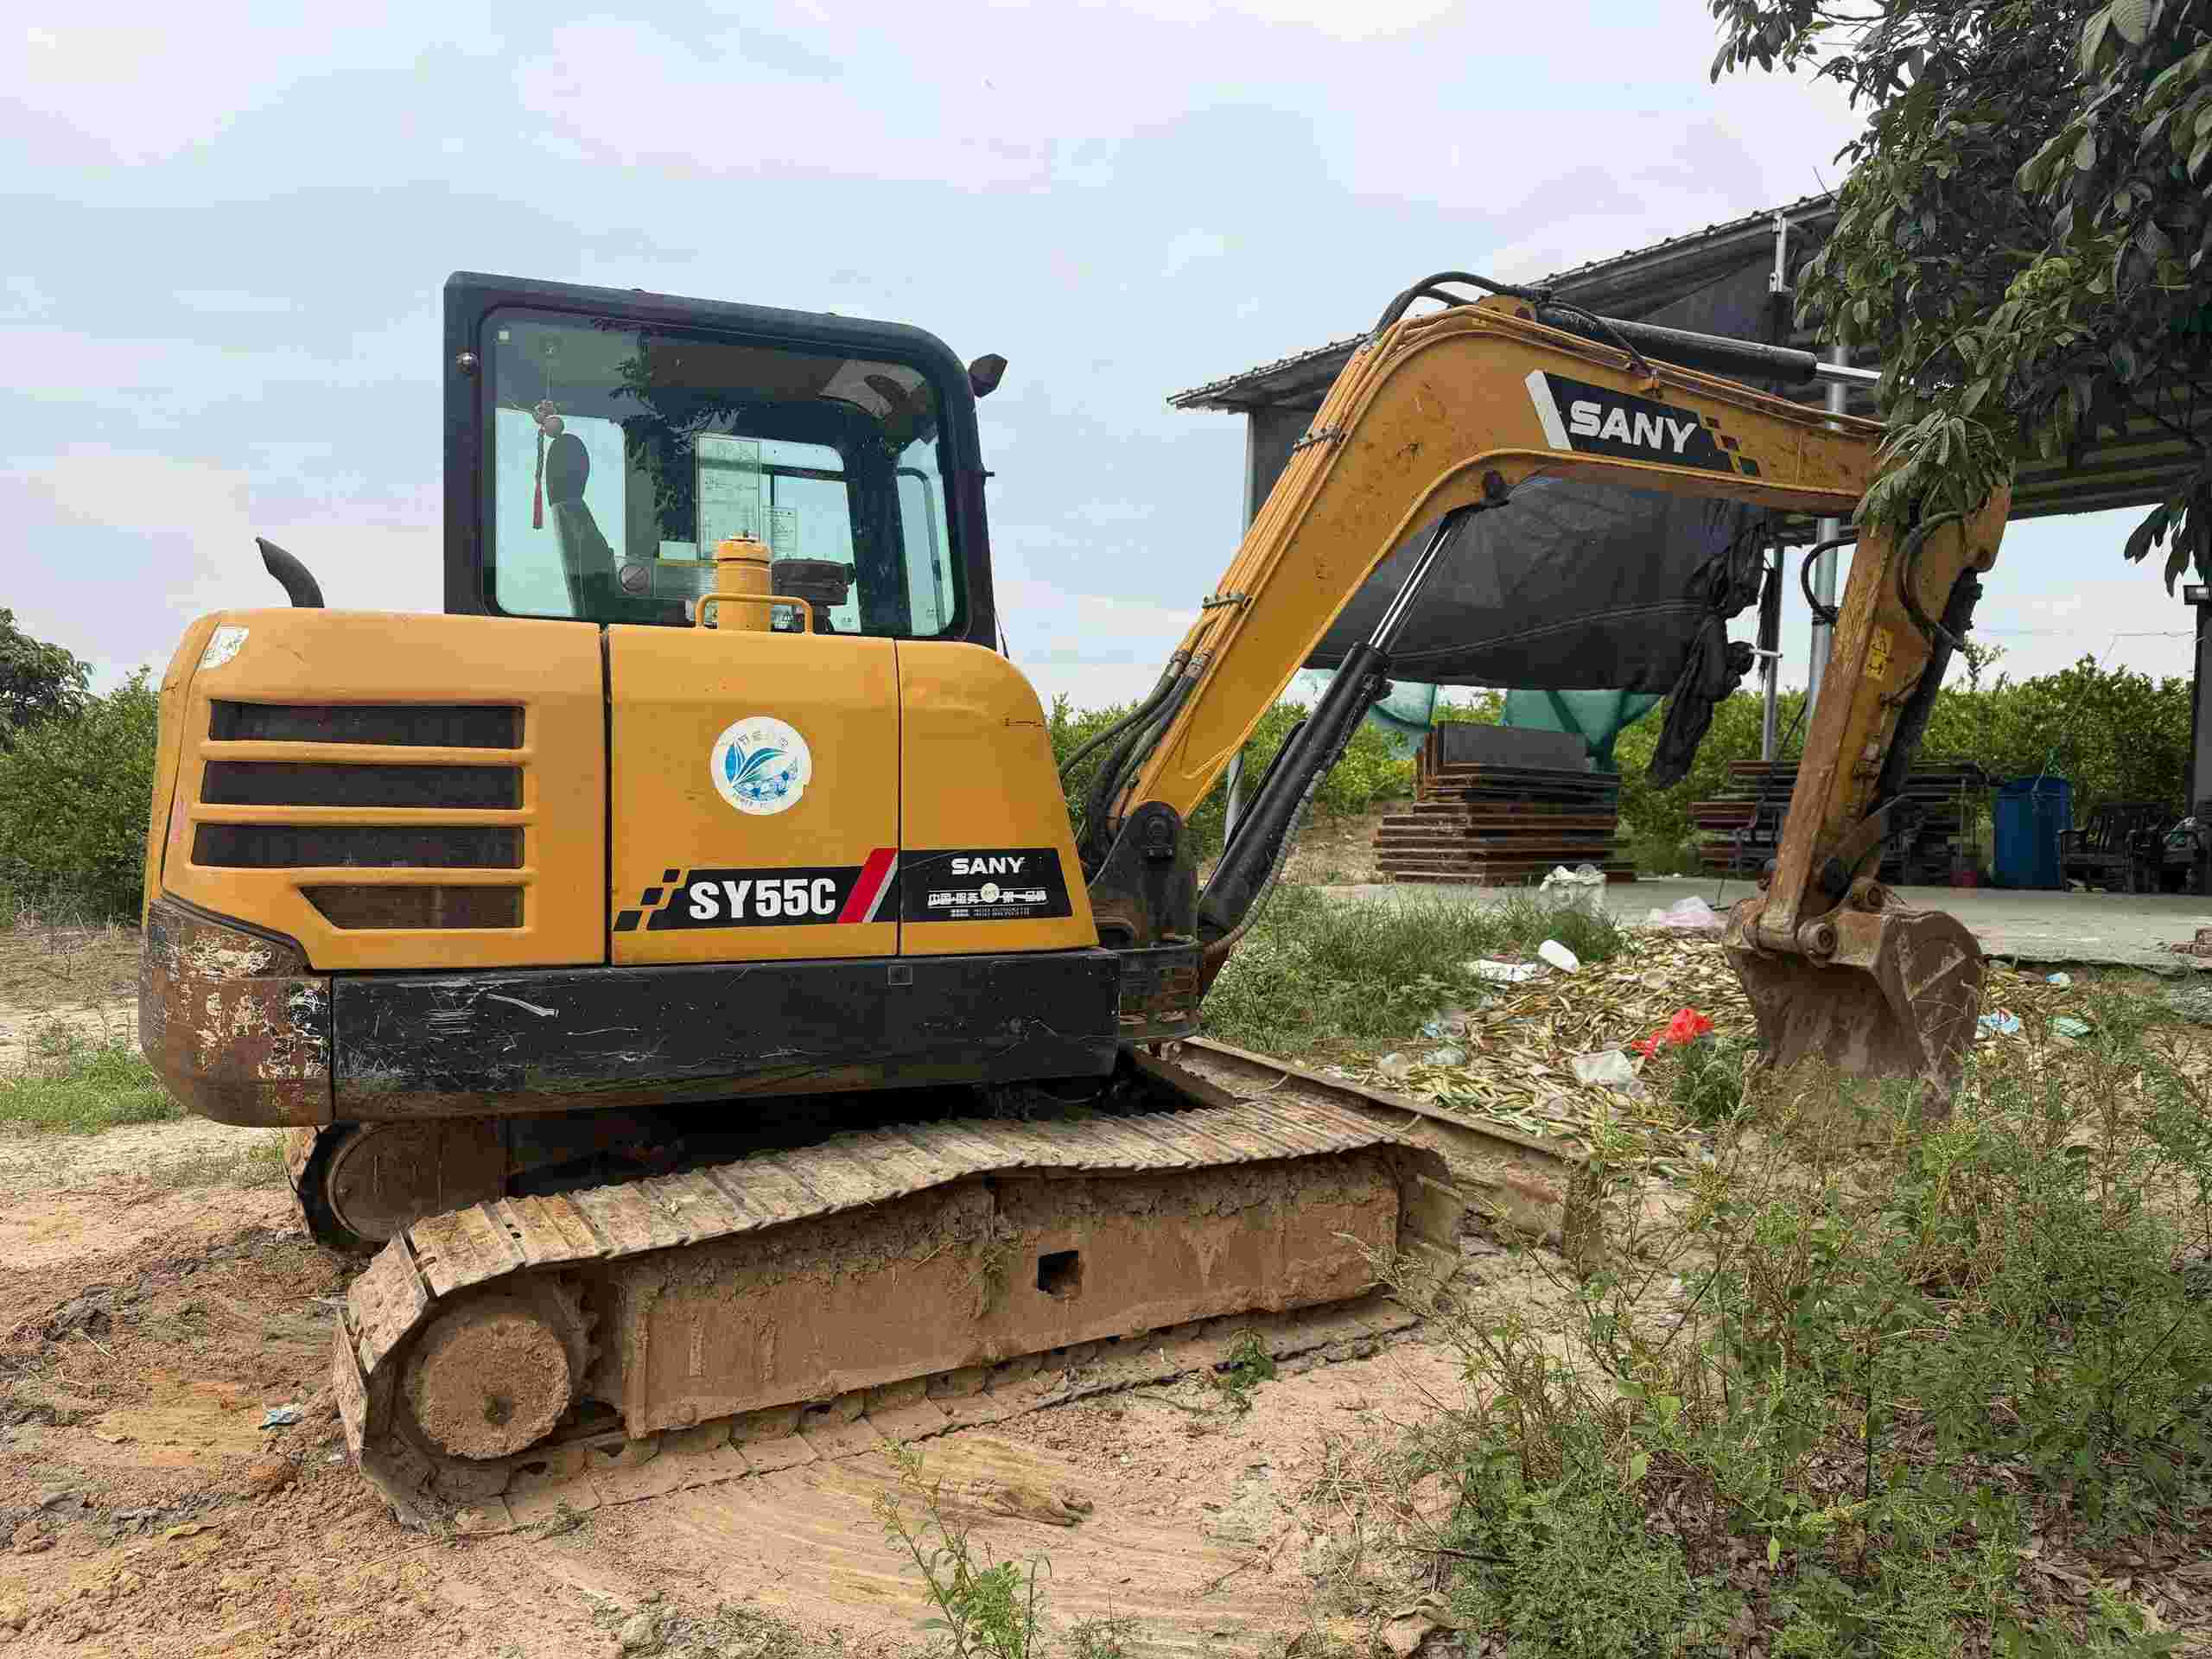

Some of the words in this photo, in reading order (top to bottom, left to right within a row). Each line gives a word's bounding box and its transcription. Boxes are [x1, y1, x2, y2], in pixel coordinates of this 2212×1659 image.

[1569, 400, 1697, 453] SANY
[951, 857, 1025, 875] SANY
[690, 878, 836, 918] SY55C
